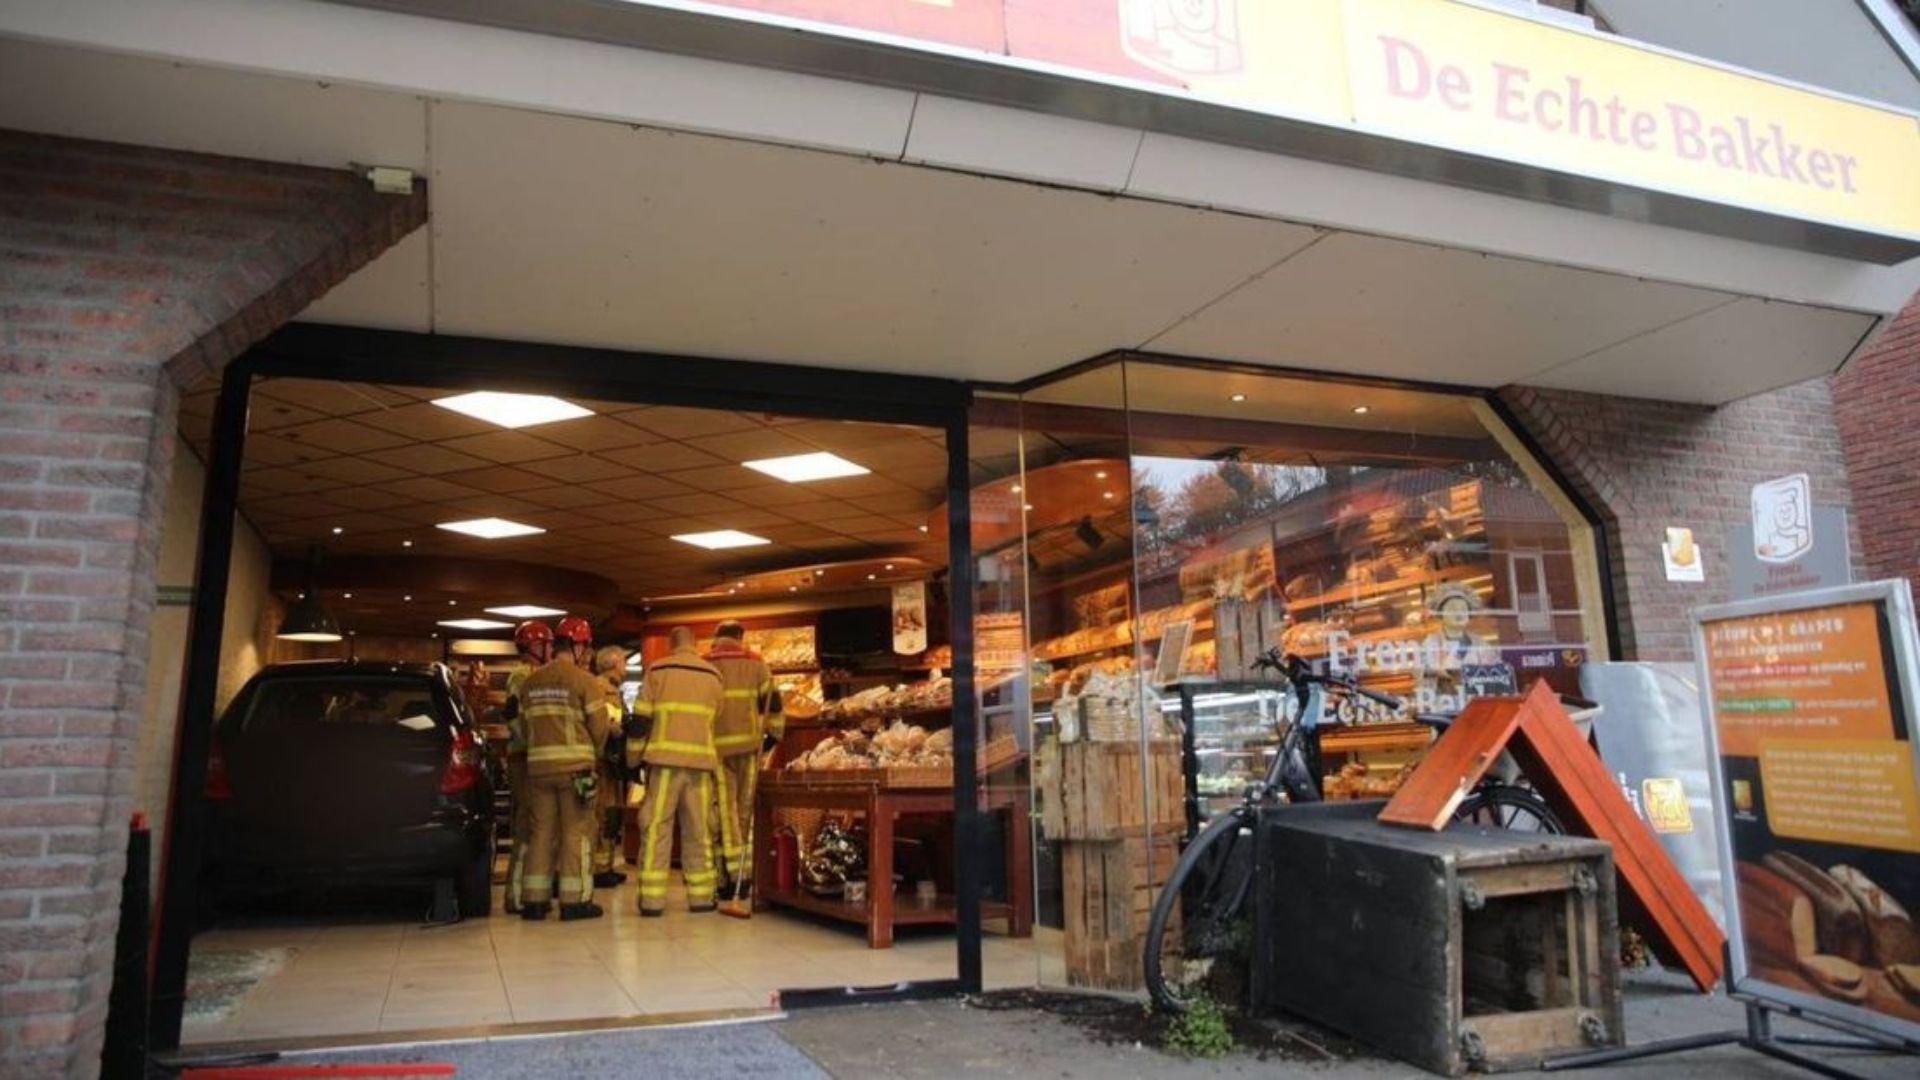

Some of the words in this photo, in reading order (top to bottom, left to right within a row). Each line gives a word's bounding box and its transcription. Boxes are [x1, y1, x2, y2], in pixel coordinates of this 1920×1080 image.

[1377, 33, 1472, 111] De
[1490, 60, 1659, 151] Echte
[1663, 101, 1858, 194] Bakker
